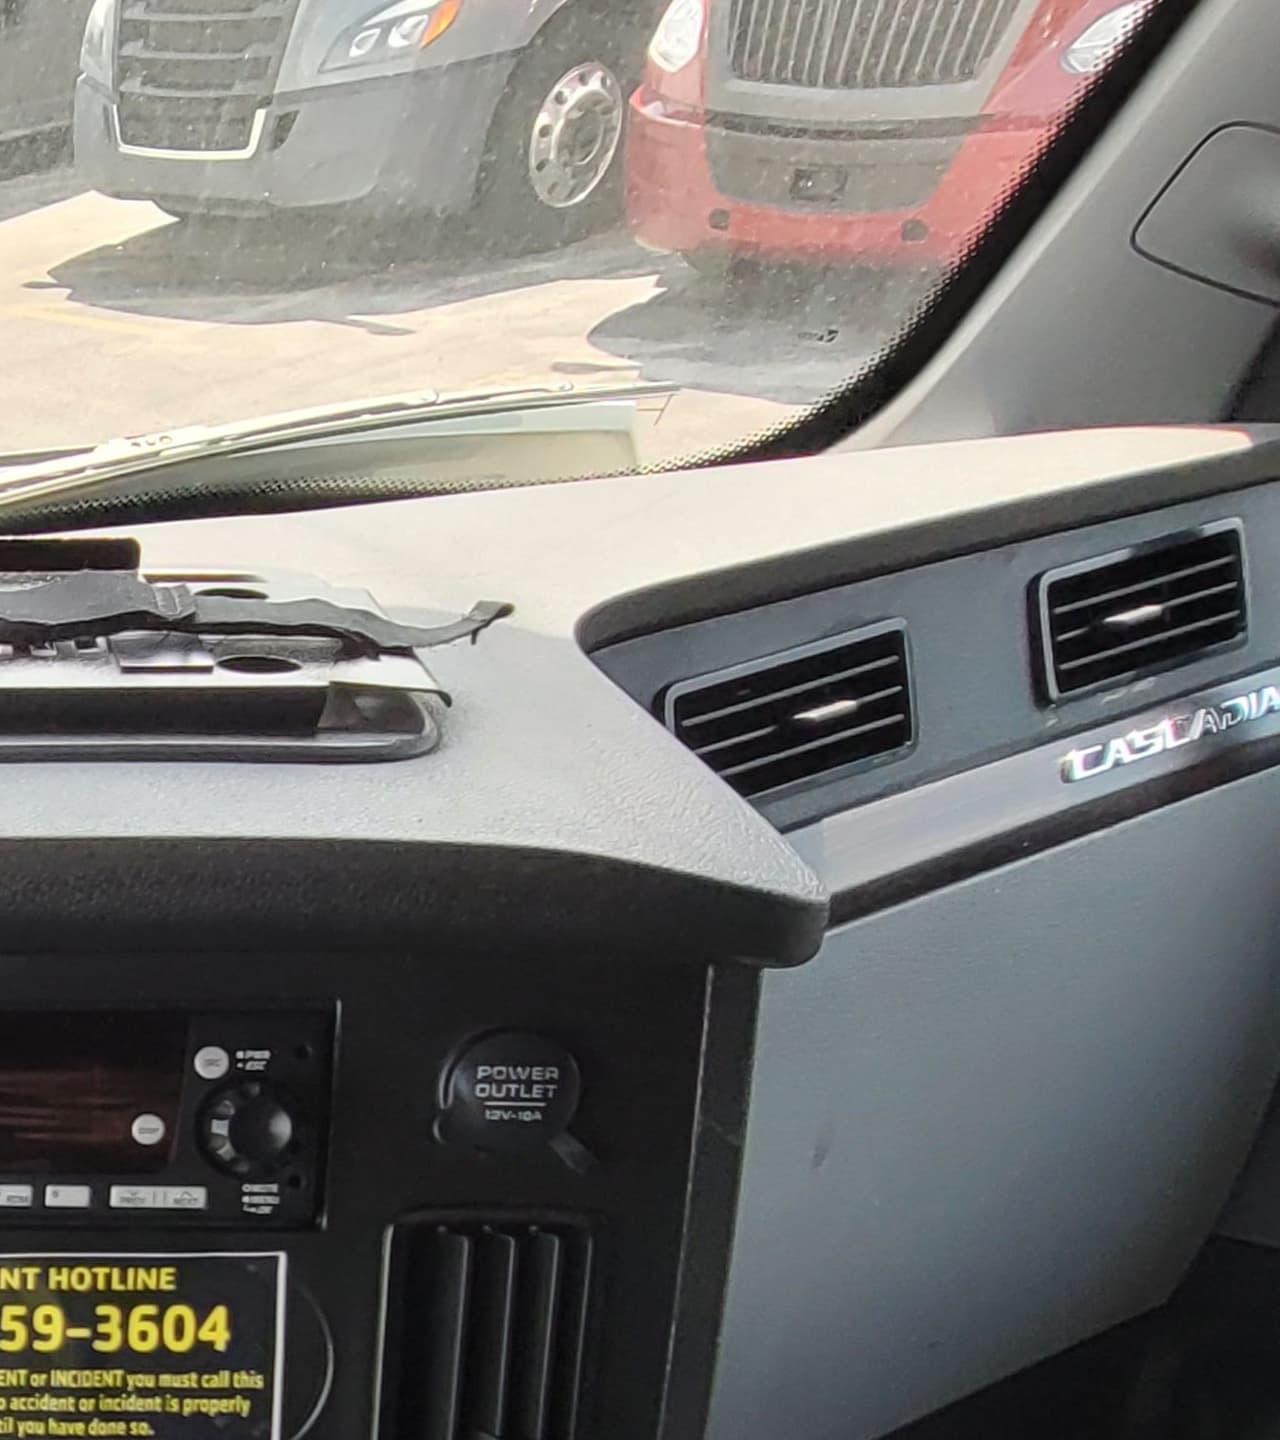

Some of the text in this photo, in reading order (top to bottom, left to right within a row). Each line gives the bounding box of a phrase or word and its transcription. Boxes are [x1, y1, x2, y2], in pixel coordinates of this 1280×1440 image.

[476, 1065, 560, 1081] POWER
[474, 1082, 558, 1099] OUTLET
[47, 1266, 177, 1292] HOTLINE
[30, 1373, 48, 1388] or
[50, 1369, 125, 1388] INCIDENT
[126, 1373, 156, 1392] you
[158, 1371, 198, 1389] must
[201, 1370, 230, 1389] call
[233, 1370, 264, 1390] this
[10, 1393, 76, 1412] accident
[78, 1397, 97, 1412] or
[99, 1394, 163, 1413] incident
[166, 1395, 180, 1413] is
[182, 1395, 252, 1418] properly
[17, 1420, 45, 1438] you
[48, 1418, 86, 1436] have
[88, 1418, 127, 1437] done
[129, 1421, 155, 1437] so.
